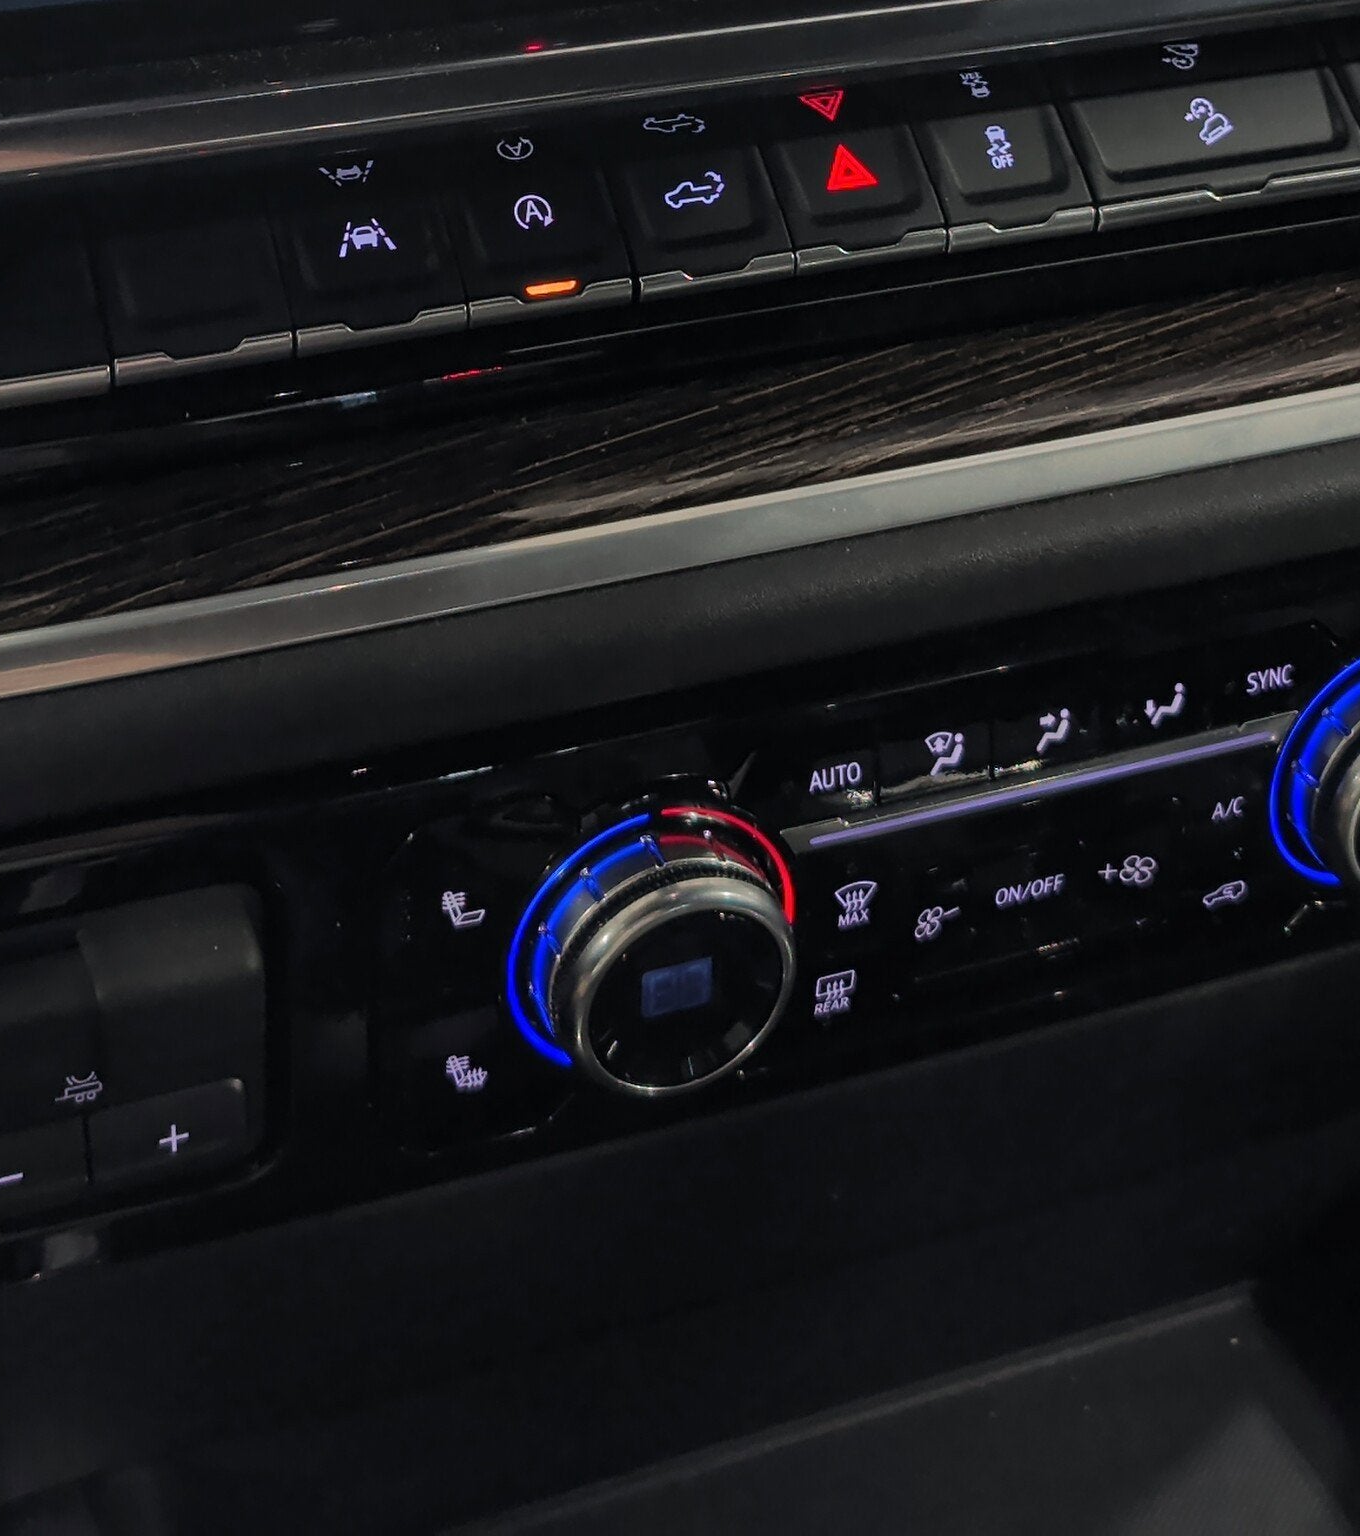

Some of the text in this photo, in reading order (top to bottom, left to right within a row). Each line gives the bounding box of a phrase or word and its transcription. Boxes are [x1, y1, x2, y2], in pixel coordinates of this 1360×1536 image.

[991, 154, 1014, 170] OFF
[1246, 664, 1293, 694] SYNC
[809, 761, 862, 792] AUTO
[1211, 795, 1244, 820] A/C
[995, 873, 1064, 906] ON/OFF
[838, 908, 870, 927] MAX
[814, 996, 850, 1015] REAR
